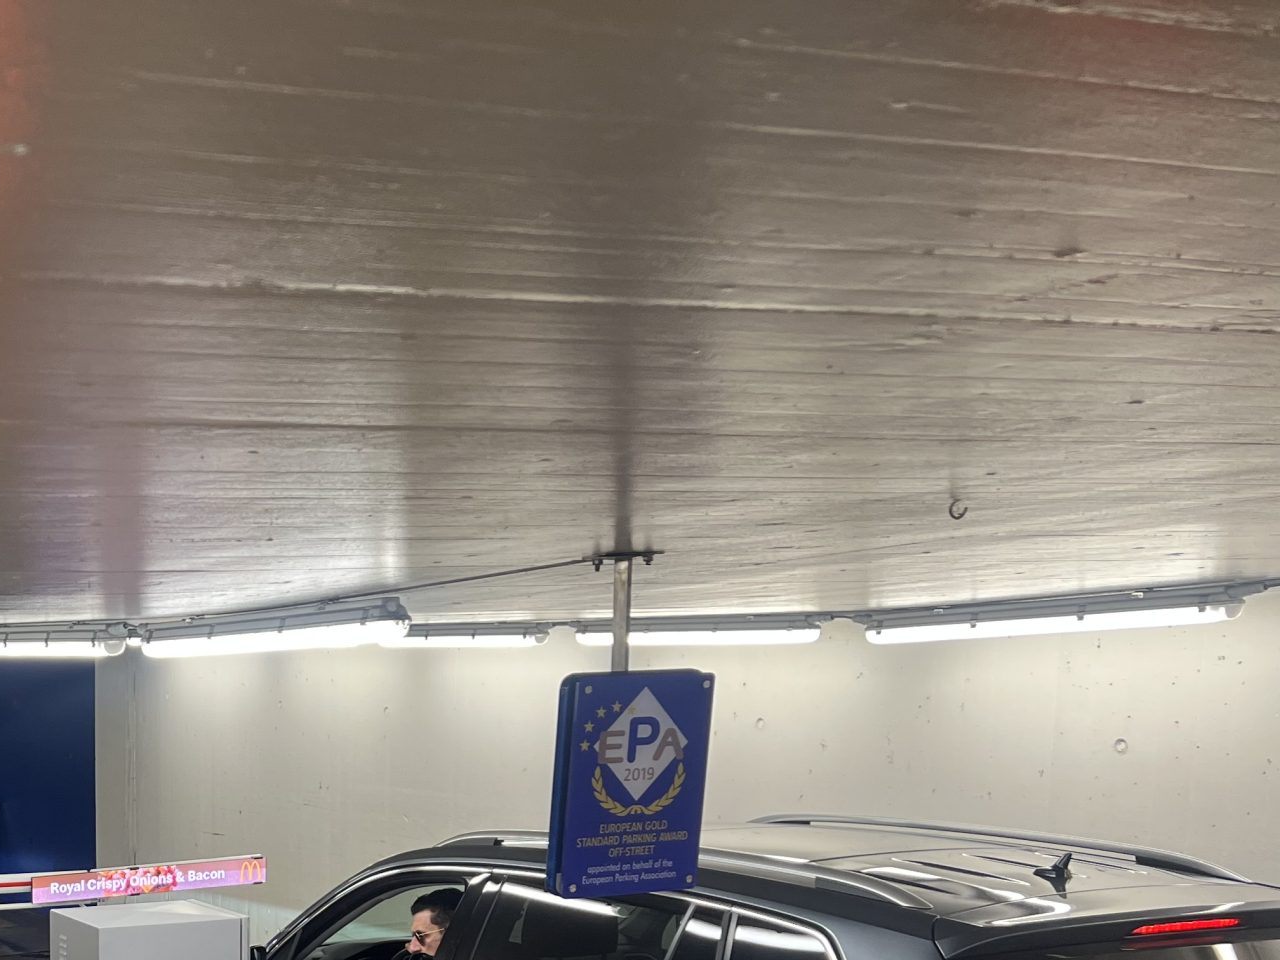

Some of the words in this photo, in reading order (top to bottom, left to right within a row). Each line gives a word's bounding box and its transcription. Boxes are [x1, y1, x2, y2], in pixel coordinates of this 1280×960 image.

[598, 716, 684, 764] EPA
[624, 767, 655, 781] 2019
[600, 822, 642, 833] EUROPEAN
[645, 820, 668, 830] GOLD
[576, 835, 619, 848] STANDARD
[622, 833, 657, 844] PARKING
[659, 831, 688, 841] AWARD
[608, 845, 656, 857] OFF-STREET
[587, 862, 620, 875] appointed
[632, 860, 653, 870] behalf
[654, 859, 662, 868] of
[662, 859, 673, 867] the
[50, 880, 85, 895] Royal
[87, 876, 127, 893] Crispy
[130, 873, 174, 887] Onions
[176, 873, 185, 883] &
[188, 869, 225, 881] Bacon
[582, 875, 613, 885] European
[615, 873, 639, 883] Parking
[640, 871, 677, 880] Association
